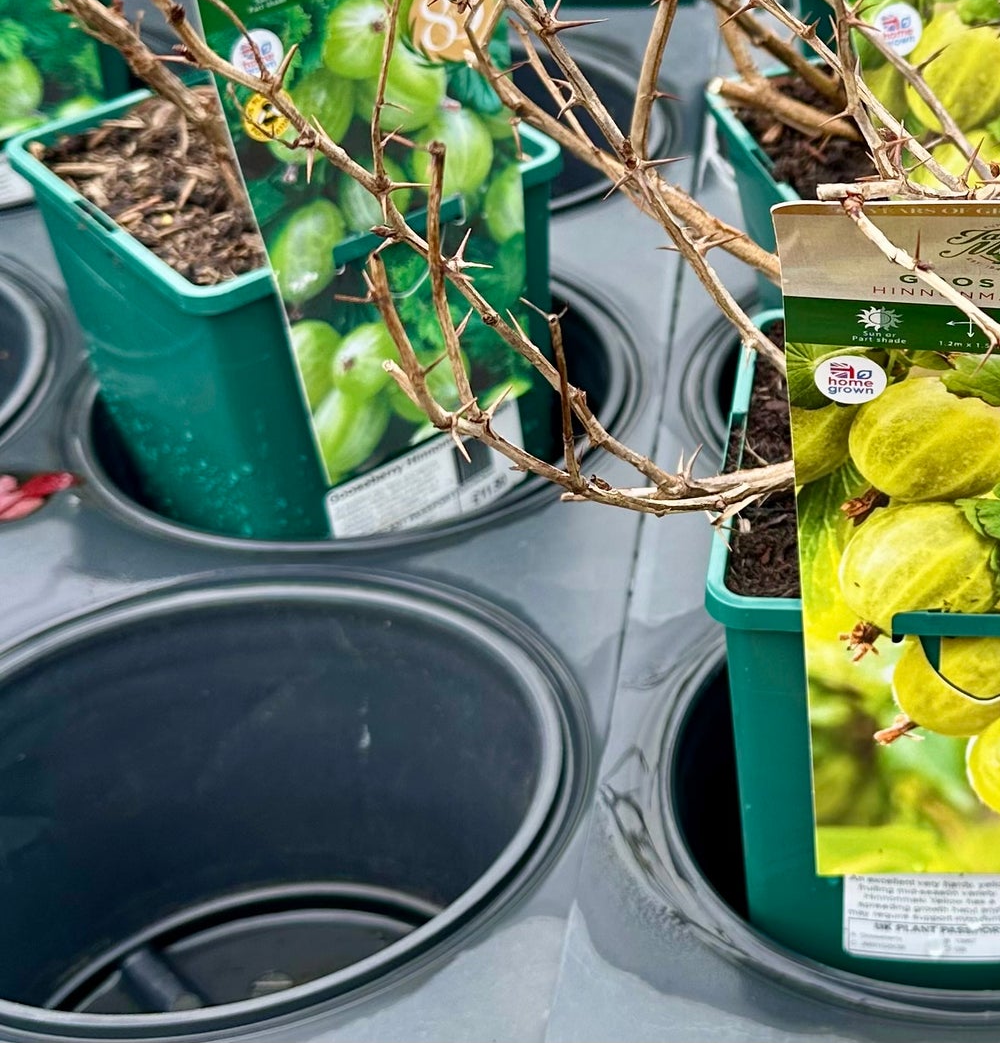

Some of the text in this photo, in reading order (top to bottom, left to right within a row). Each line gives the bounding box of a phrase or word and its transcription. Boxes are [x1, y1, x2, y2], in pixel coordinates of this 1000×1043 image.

[863, 330, 882, 338] Sun
[852, 335, 907, 345] Part shade
[828, 377, 874, 388] home
[828, 386, 874, 395] grown
[874, 922, 892, 931] UK
[896, 923, 936, 933] PLANT
